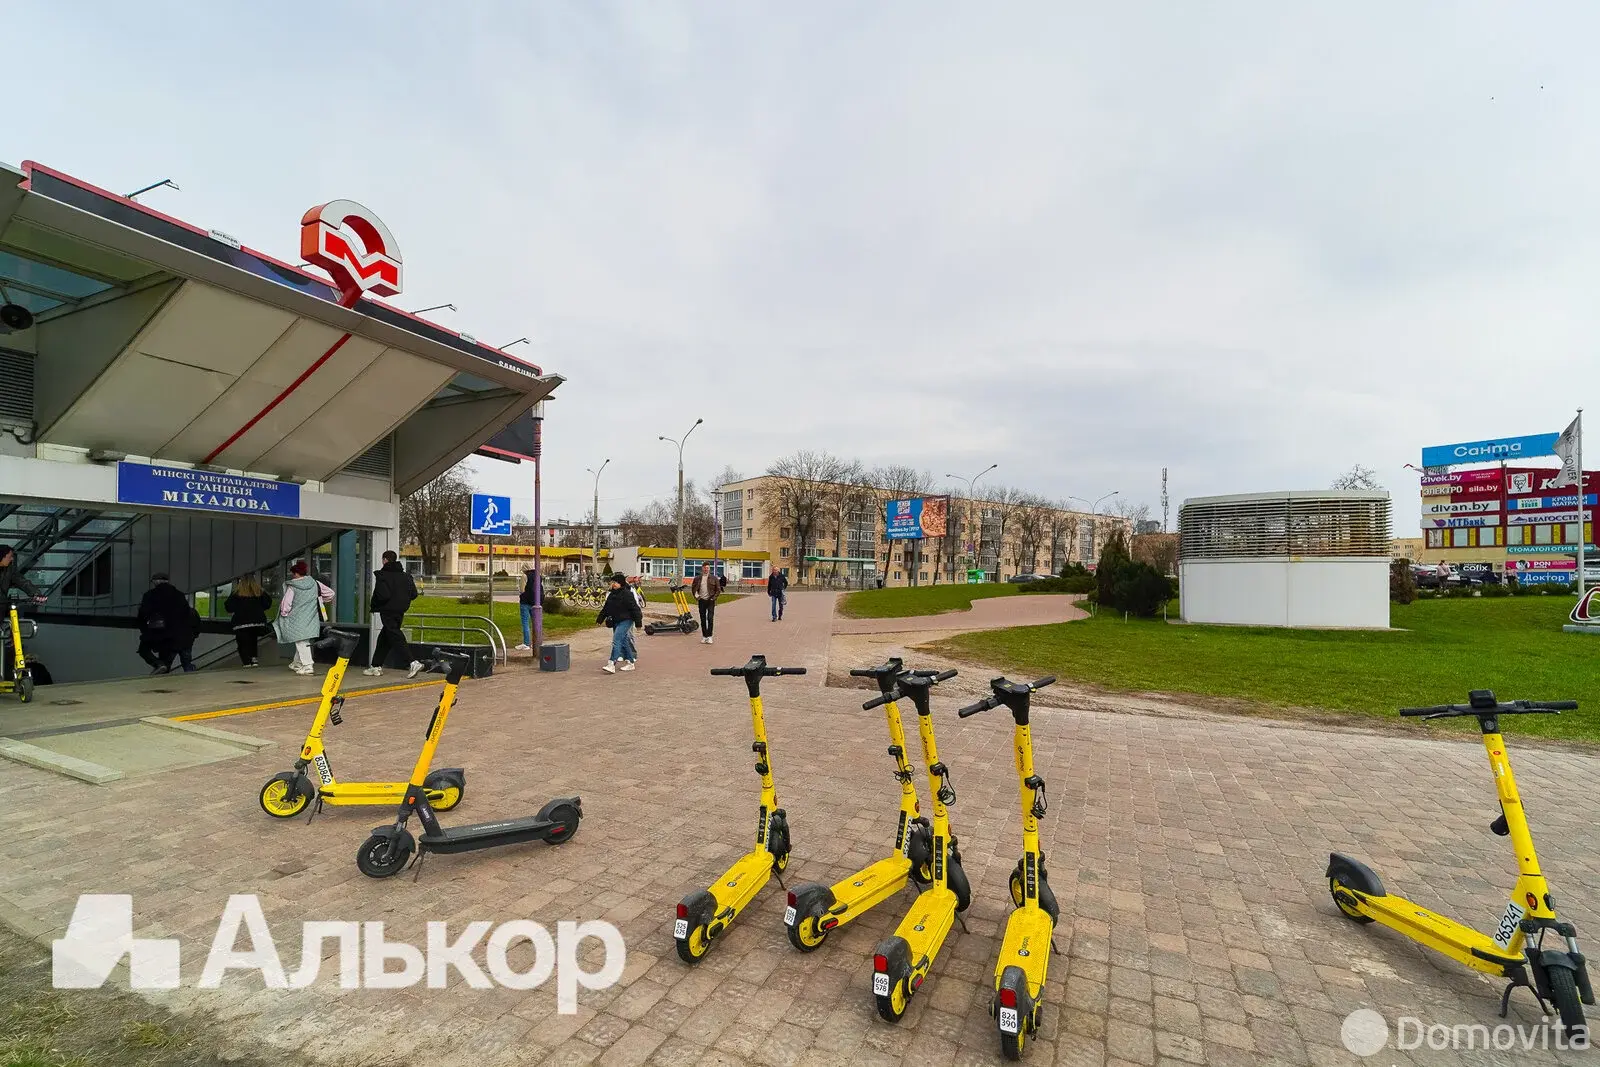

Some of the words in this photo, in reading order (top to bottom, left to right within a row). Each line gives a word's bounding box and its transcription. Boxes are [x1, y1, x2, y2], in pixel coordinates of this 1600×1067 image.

[1454, 442, 1522, 458] Санта
[1421, 473, 1463, 484] 21vek.by
[1539, 475, 1591, 490] KC
[186, 481, 253, 496] СТАНЦЫЯ
[1422, 485, 1463, 496] ЭЛЕКТРО
[1468, 484, 1498, 493] sila.by
[163, 490, 271, 511] МІХАЛОВА
[1431, 501, 1490, 513] divan.by
[1447, 516, 1486, 527] МТБанк
[1528, 513, 1590, 523] БЕЛГОССТРХ
[1523, 572, 1565, 582] Доктор
[315, 756, 332, 785] 830862
[1495, 903, 1523, 946] 965241
[875, 977, 888, 986] 665
[875, 984, 887, 992] 578
[1001, 1011, 1016, 1020] 824
[1001, 1020, 1016, 1029] 390
